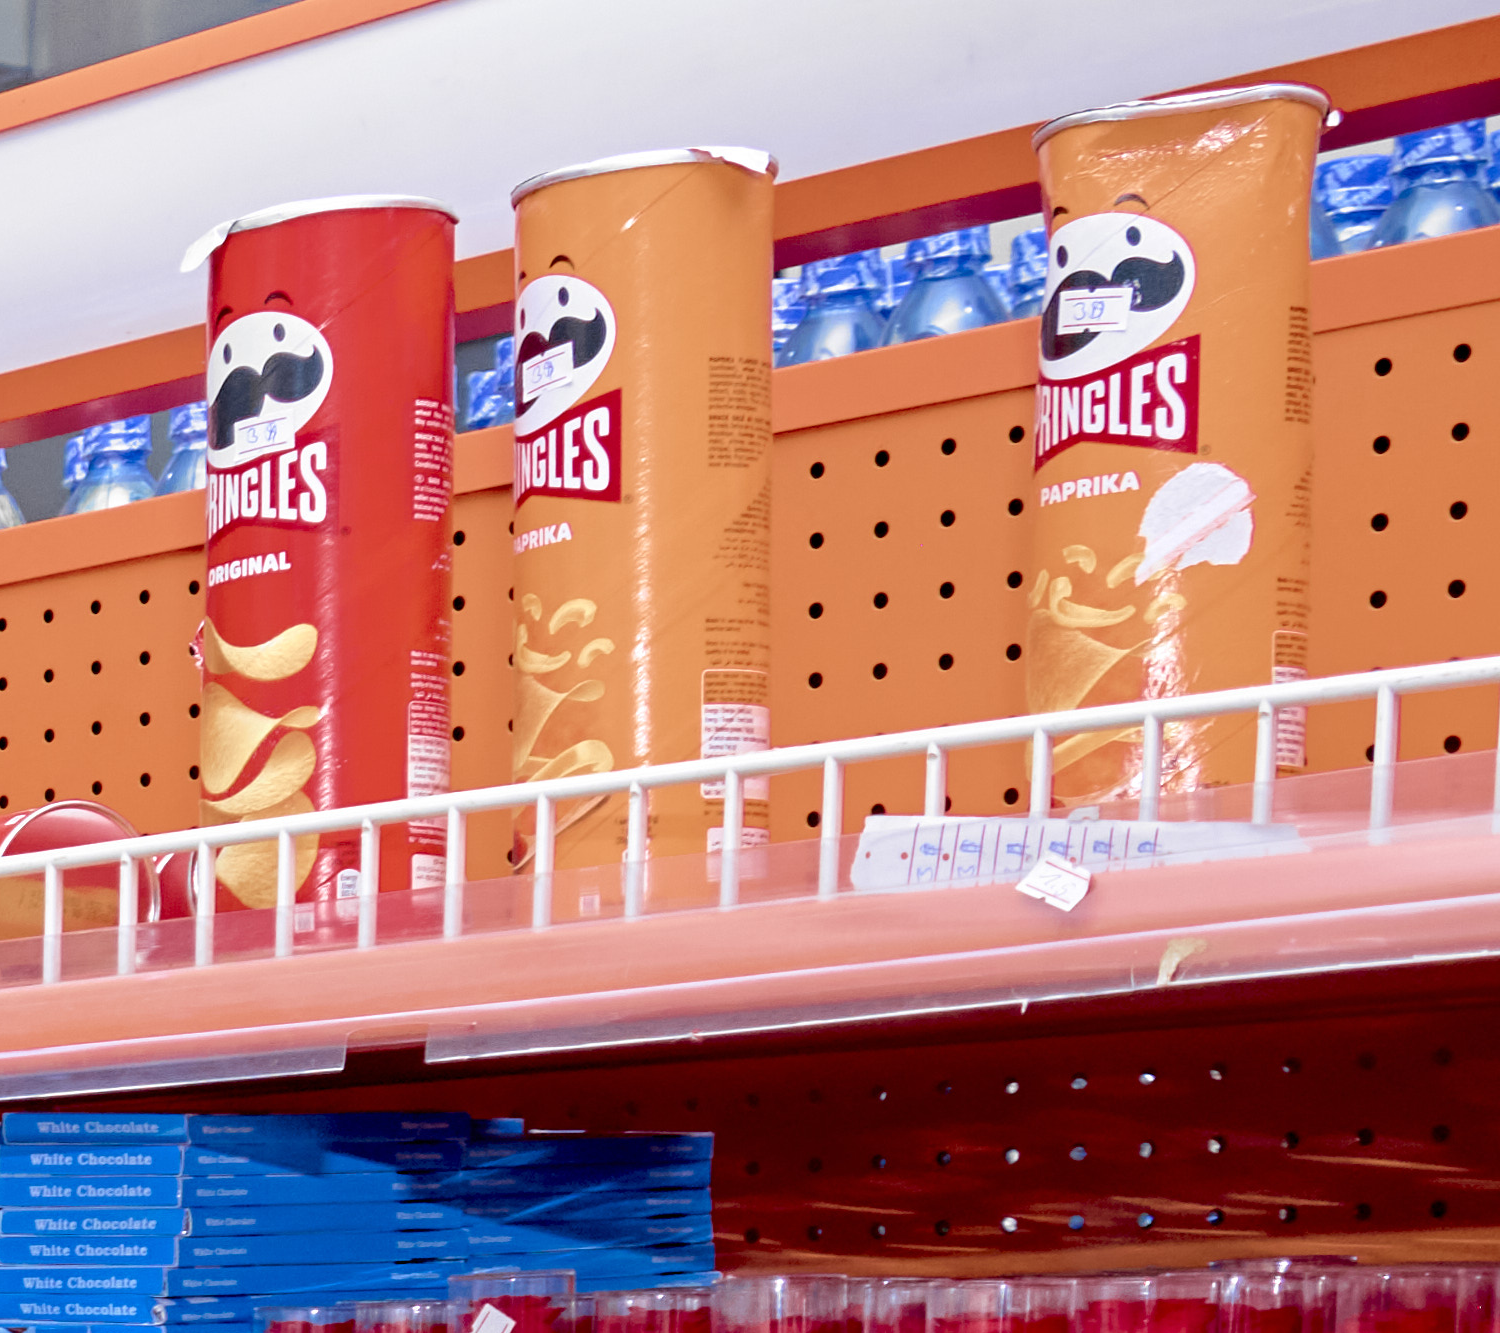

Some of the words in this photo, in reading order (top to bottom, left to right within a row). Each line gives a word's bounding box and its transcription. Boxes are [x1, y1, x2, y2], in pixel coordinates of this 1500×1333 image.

[207, 440, 327, 540] RINGLES
[1040, 471, 1140, 507] PAPRIKA
[208, 551, 291, 587] ORIGINAL
